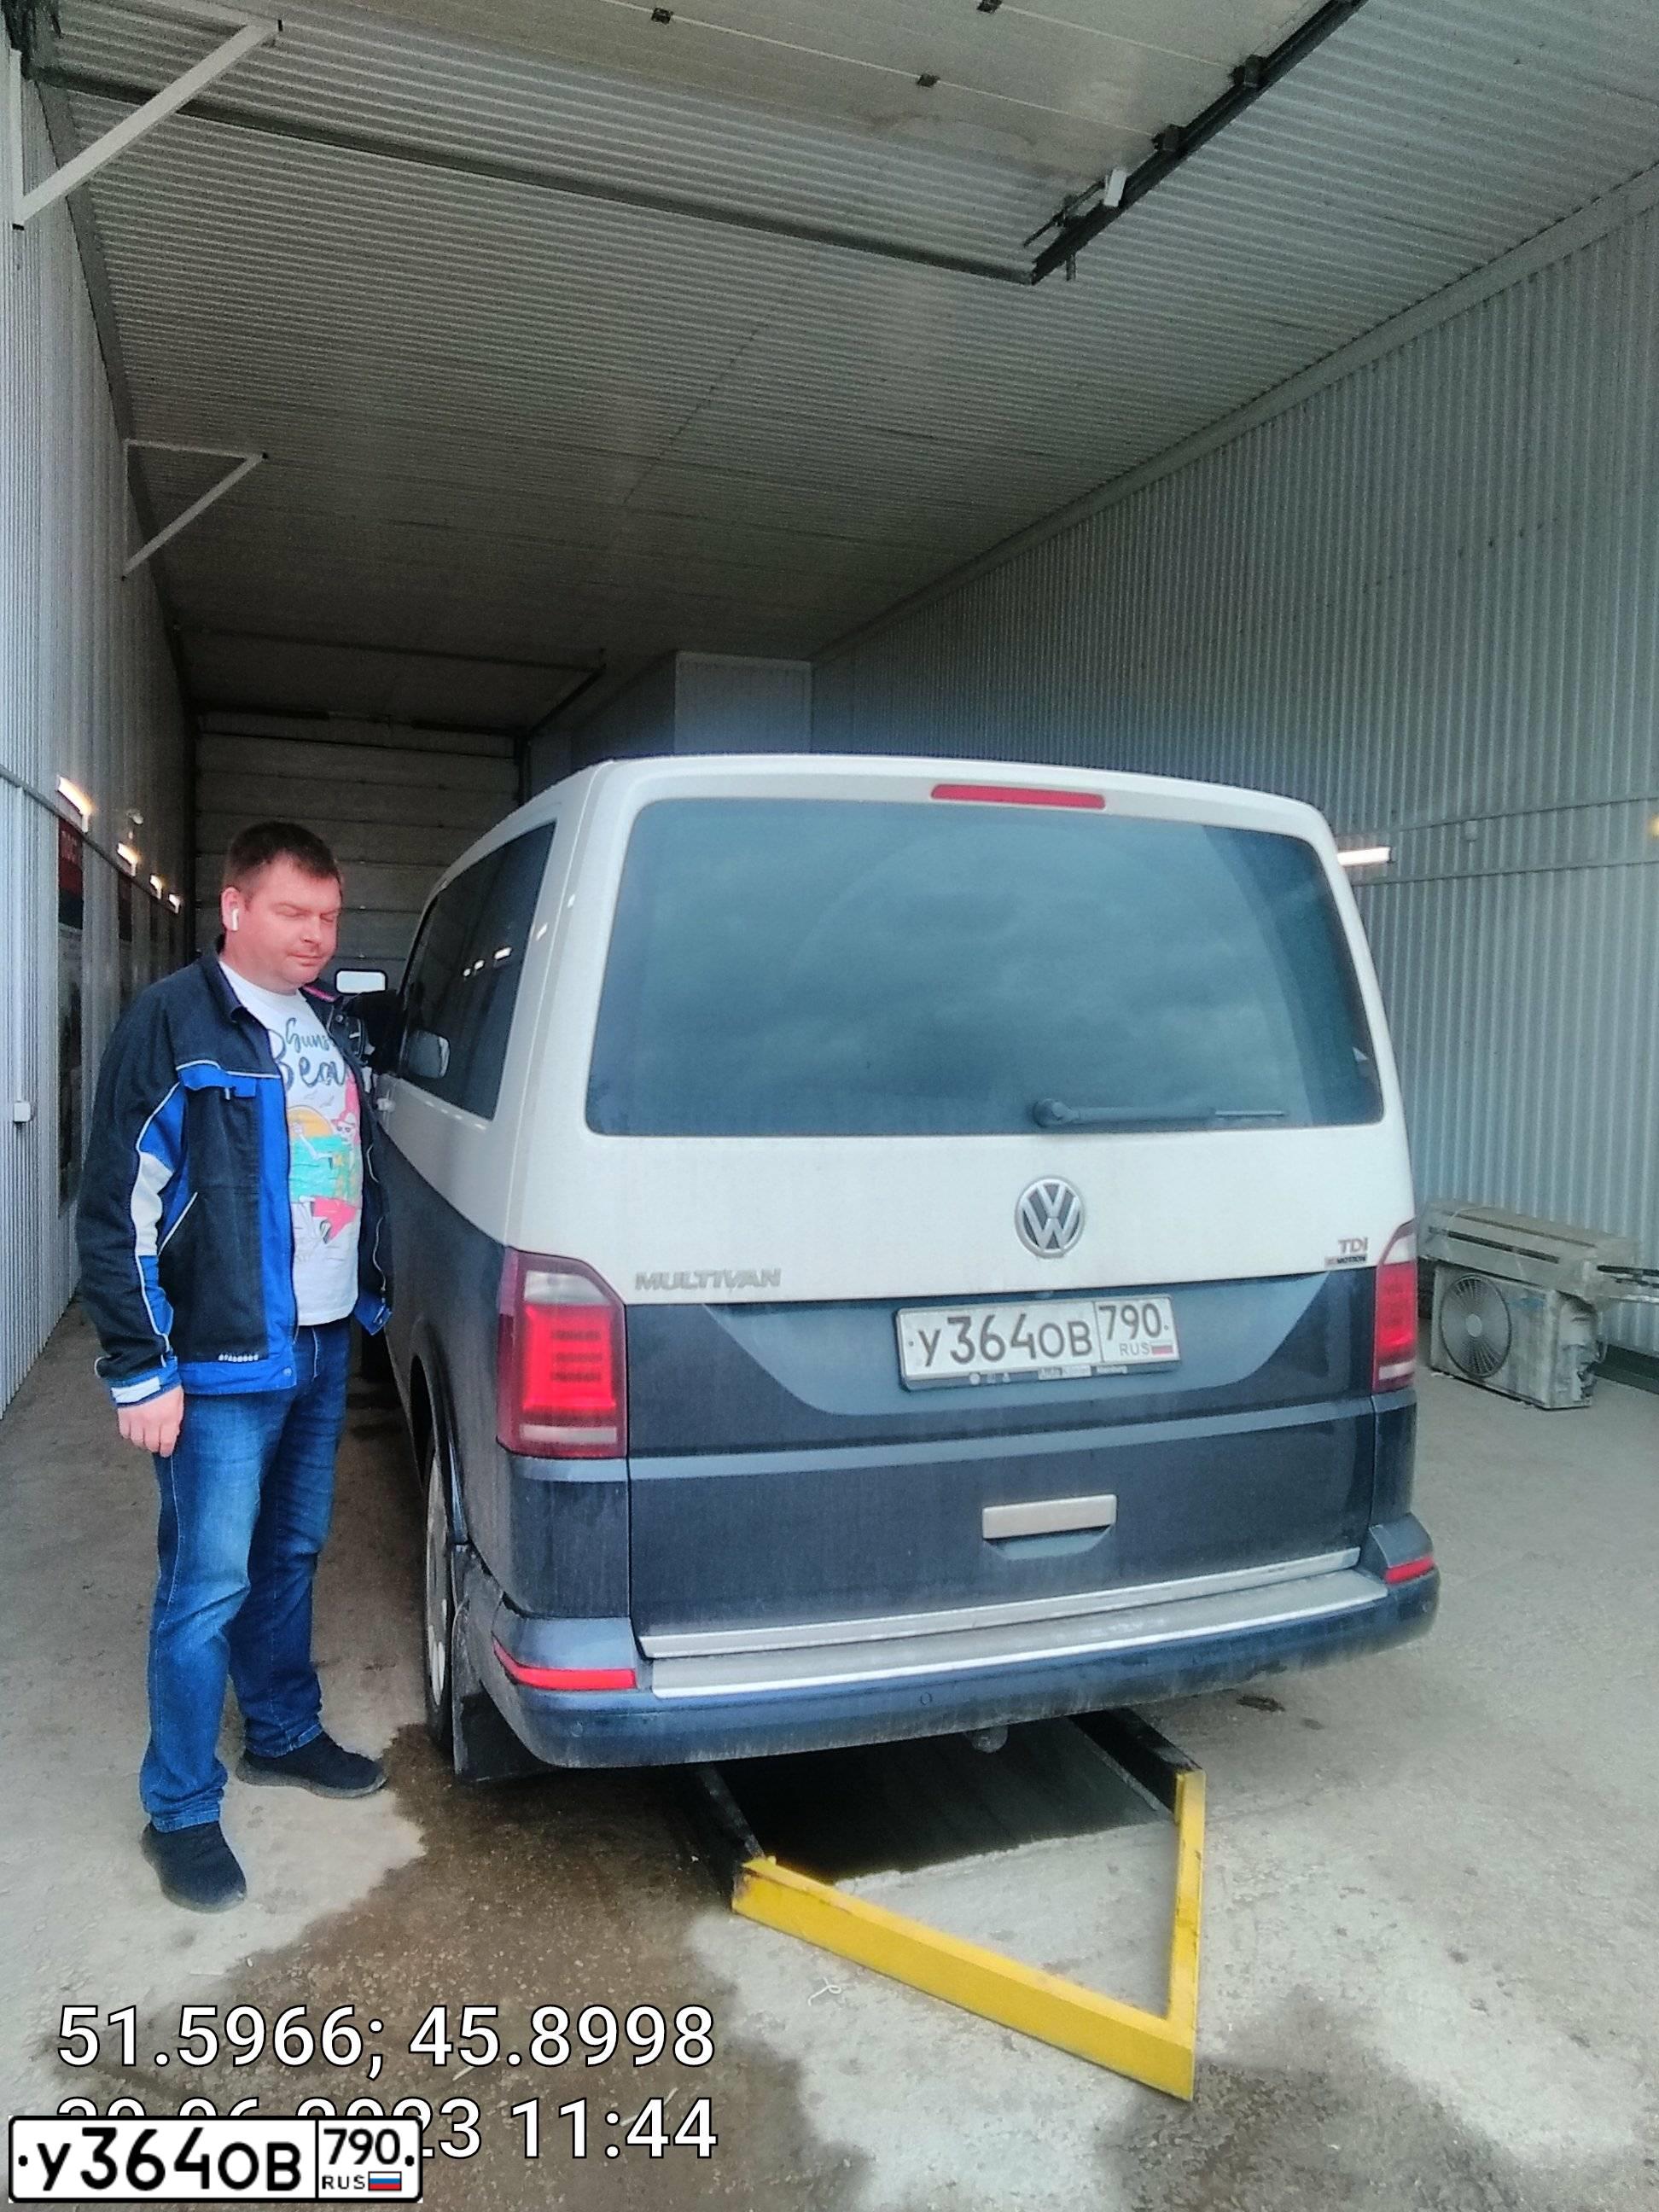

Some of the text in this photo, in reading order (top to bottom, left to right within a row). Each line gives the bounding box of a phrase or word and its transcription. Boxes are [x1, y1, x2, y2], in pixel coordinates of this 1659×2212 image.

[1338, 1237, 1368, 1253] TDI
[635, 1268, 782, 1290] MULTIVAN
[1098, 1303, 1161, 1341] 790
[1120, 1342, 1151, 1356] RUS
